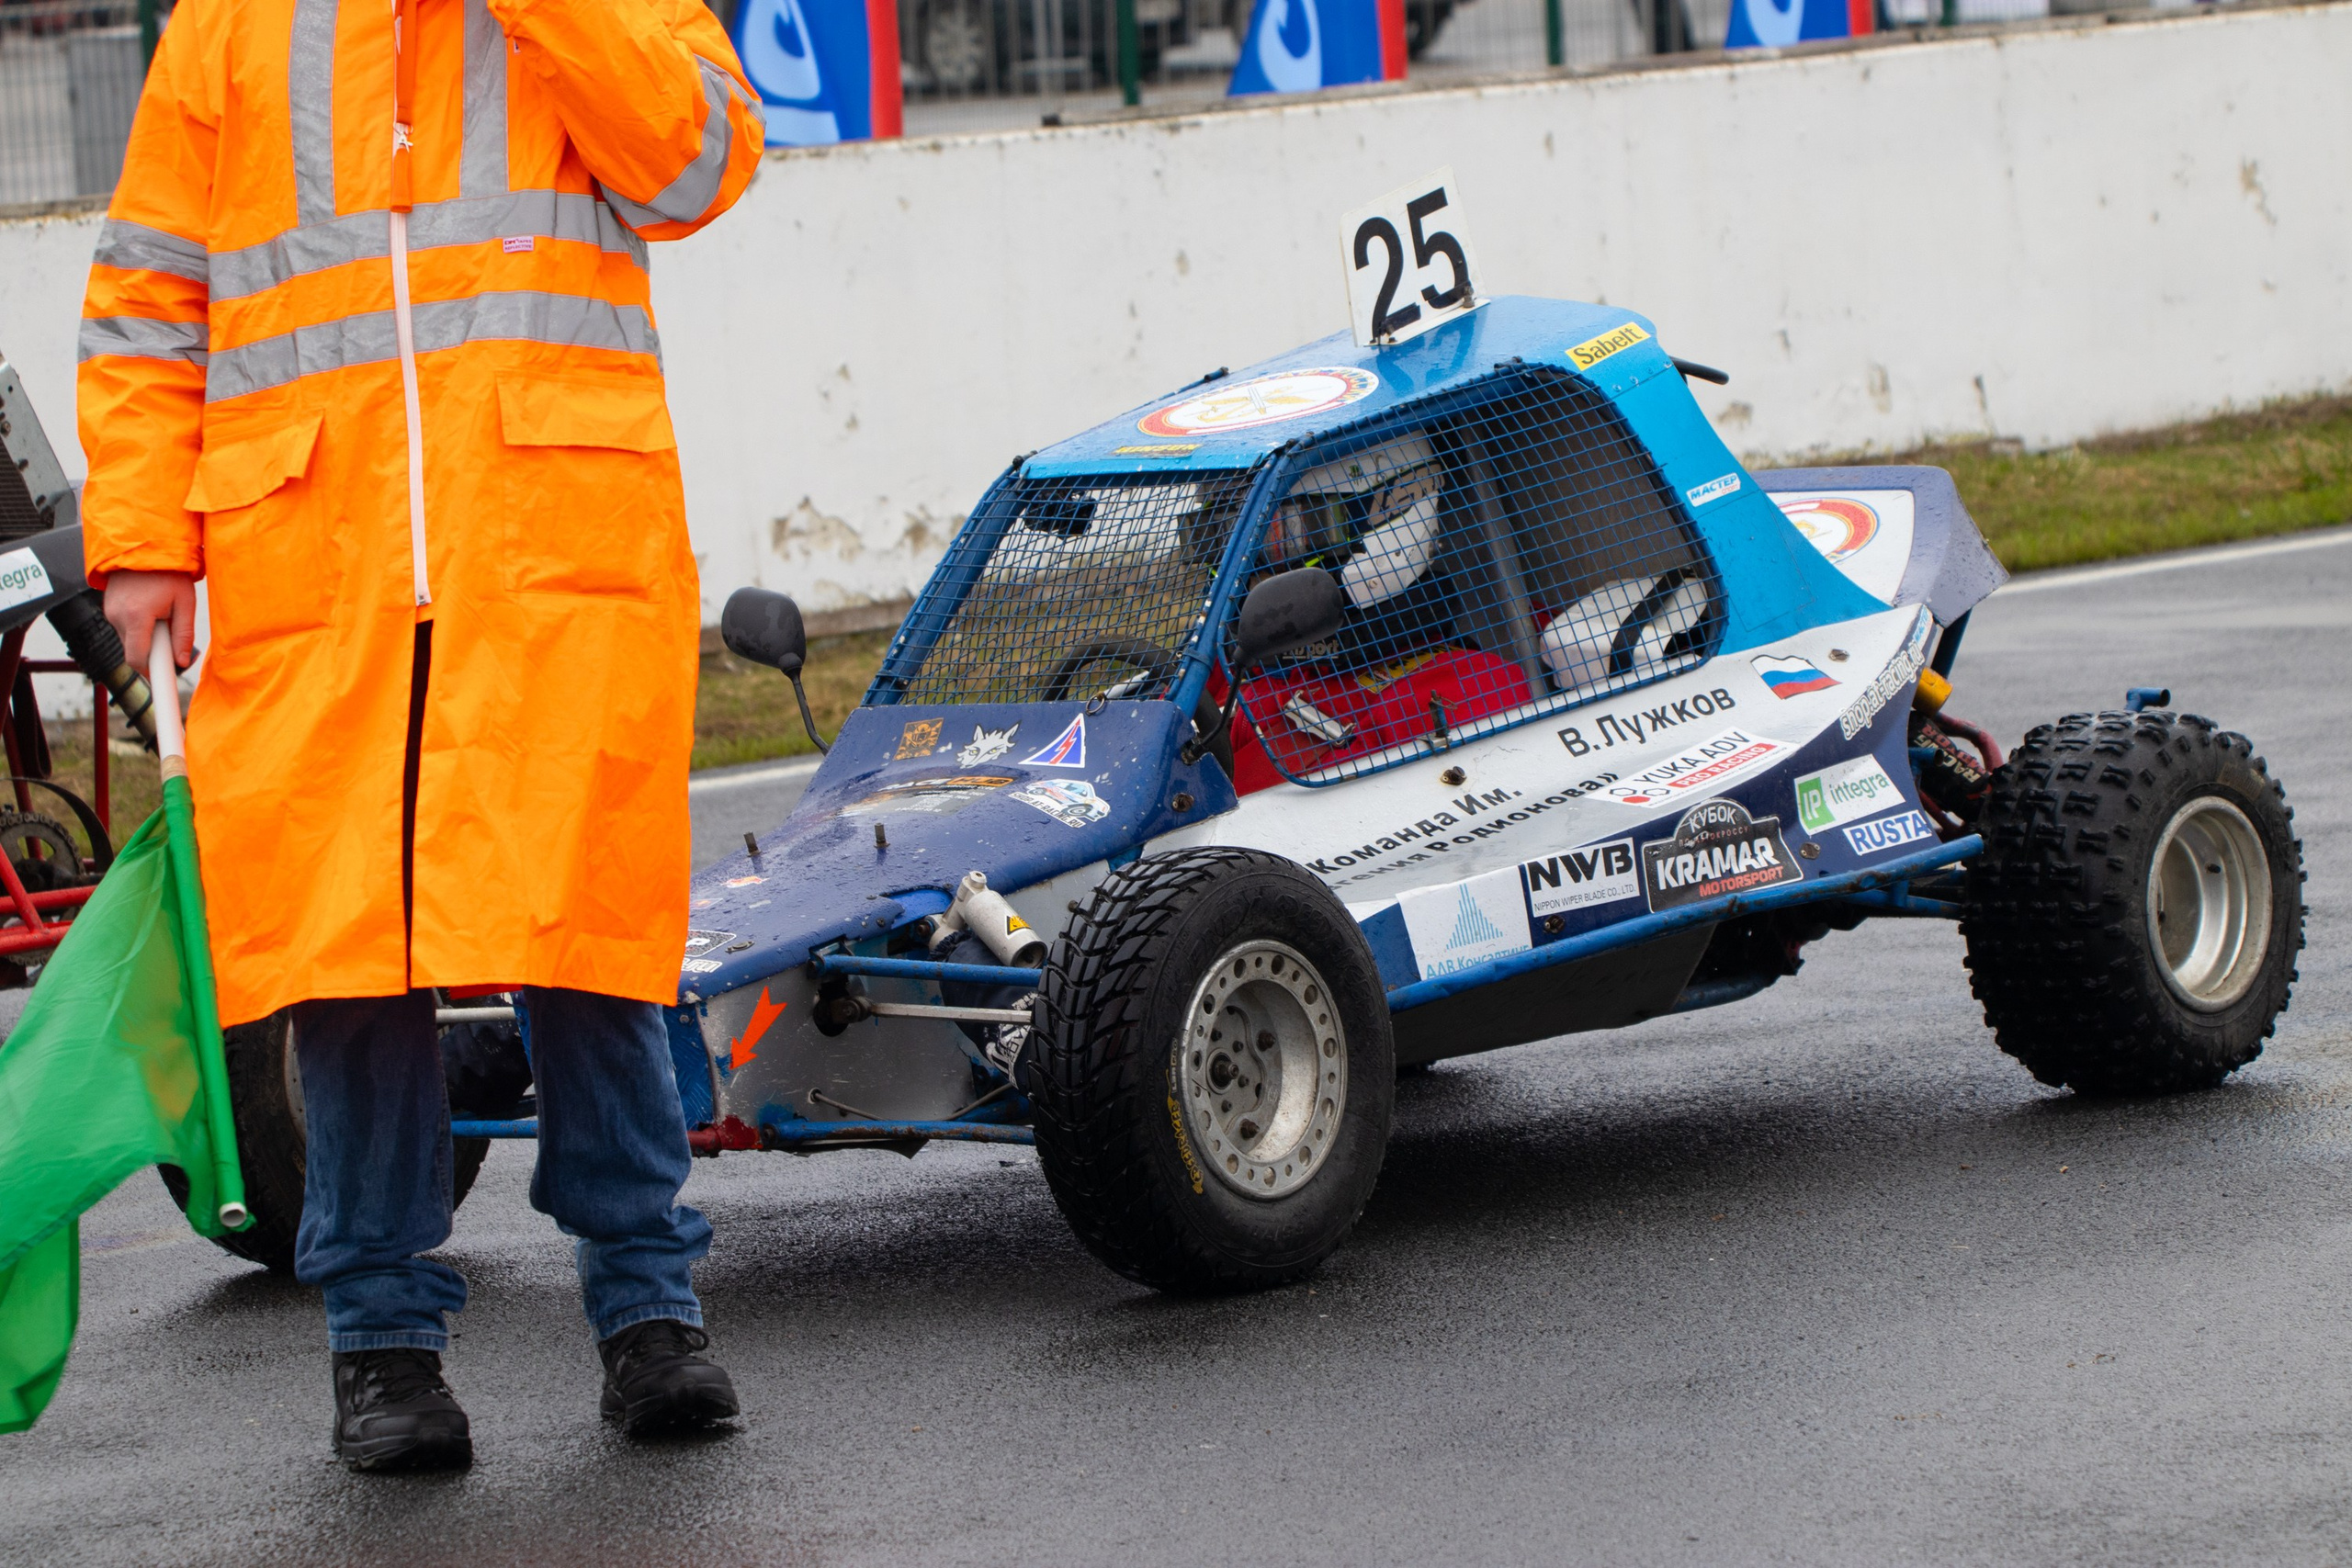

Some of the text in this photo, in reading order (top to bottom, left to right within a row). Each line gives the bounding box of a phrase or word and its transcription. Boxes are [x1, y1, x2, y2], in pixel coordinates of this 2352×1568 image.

[1354, 186, 1472, 338] 25
[1573, 326, 1642, 365] Sabelt
[1690, 475, 1737, 500] МАСТЕР
[0, 564, 42, 591] egra
[1634, 757, 1705, 784] YUKA
[1701, 731, 1750, 759] ADV
[1678, 746, 1768, 788] PRO RACING
[1828, 773, 1890, 805] integra
[1306, 787, 1523, 874] Команда Им.
[1690, 806, 1736, 833] КУБОК
[1849, 813, 1930, 852] RUSTA
[1527, 842, 1634, 892] NWB
[1657, 837, 1781, 890] KRAMAR
[1699, 865, 1784, 897] MOTORSPORT
[1534, 898, 1561, 911] NIPPON
[1562, 894, 1582, 906] WIPER
[1585, 889, 1606, 902] BLADE
